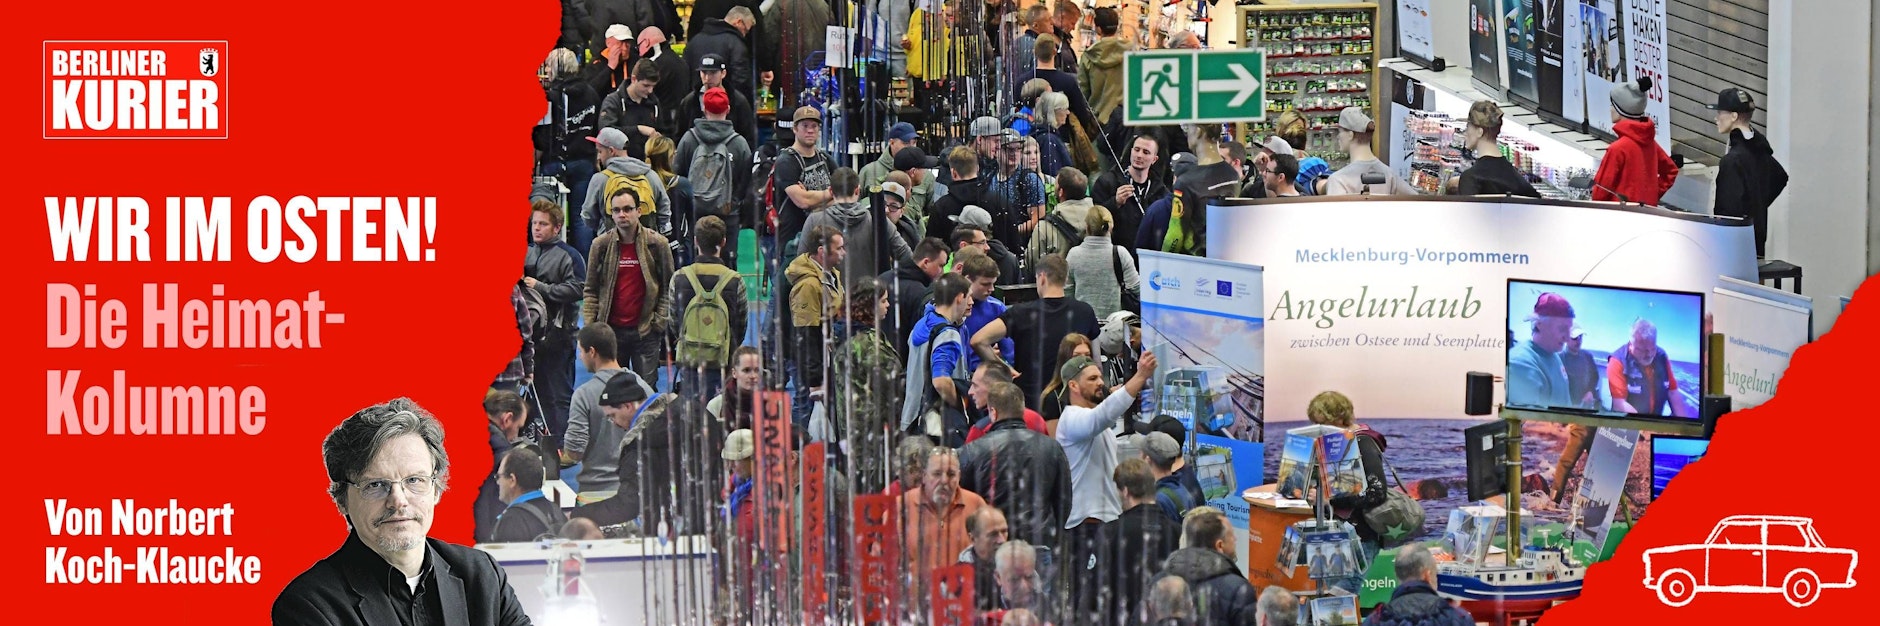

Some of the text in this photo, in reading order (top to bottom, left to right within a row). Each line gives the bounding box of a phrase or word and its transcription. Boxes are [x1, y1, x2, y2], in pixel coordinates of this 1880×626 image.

[1632, 12, 1662, 44] HAKEN
[1634, 39, 1662, 71] BESTER
[1295, 248, 1529, 265] Mecklenburg-Vorpommern
[1268, 285, 1482, 329] Angelurlaub
[1290, 332, 1505, 351] zwischen Ostsee und Seenplatte
[1362, 576, 1396, 591] ngeln
